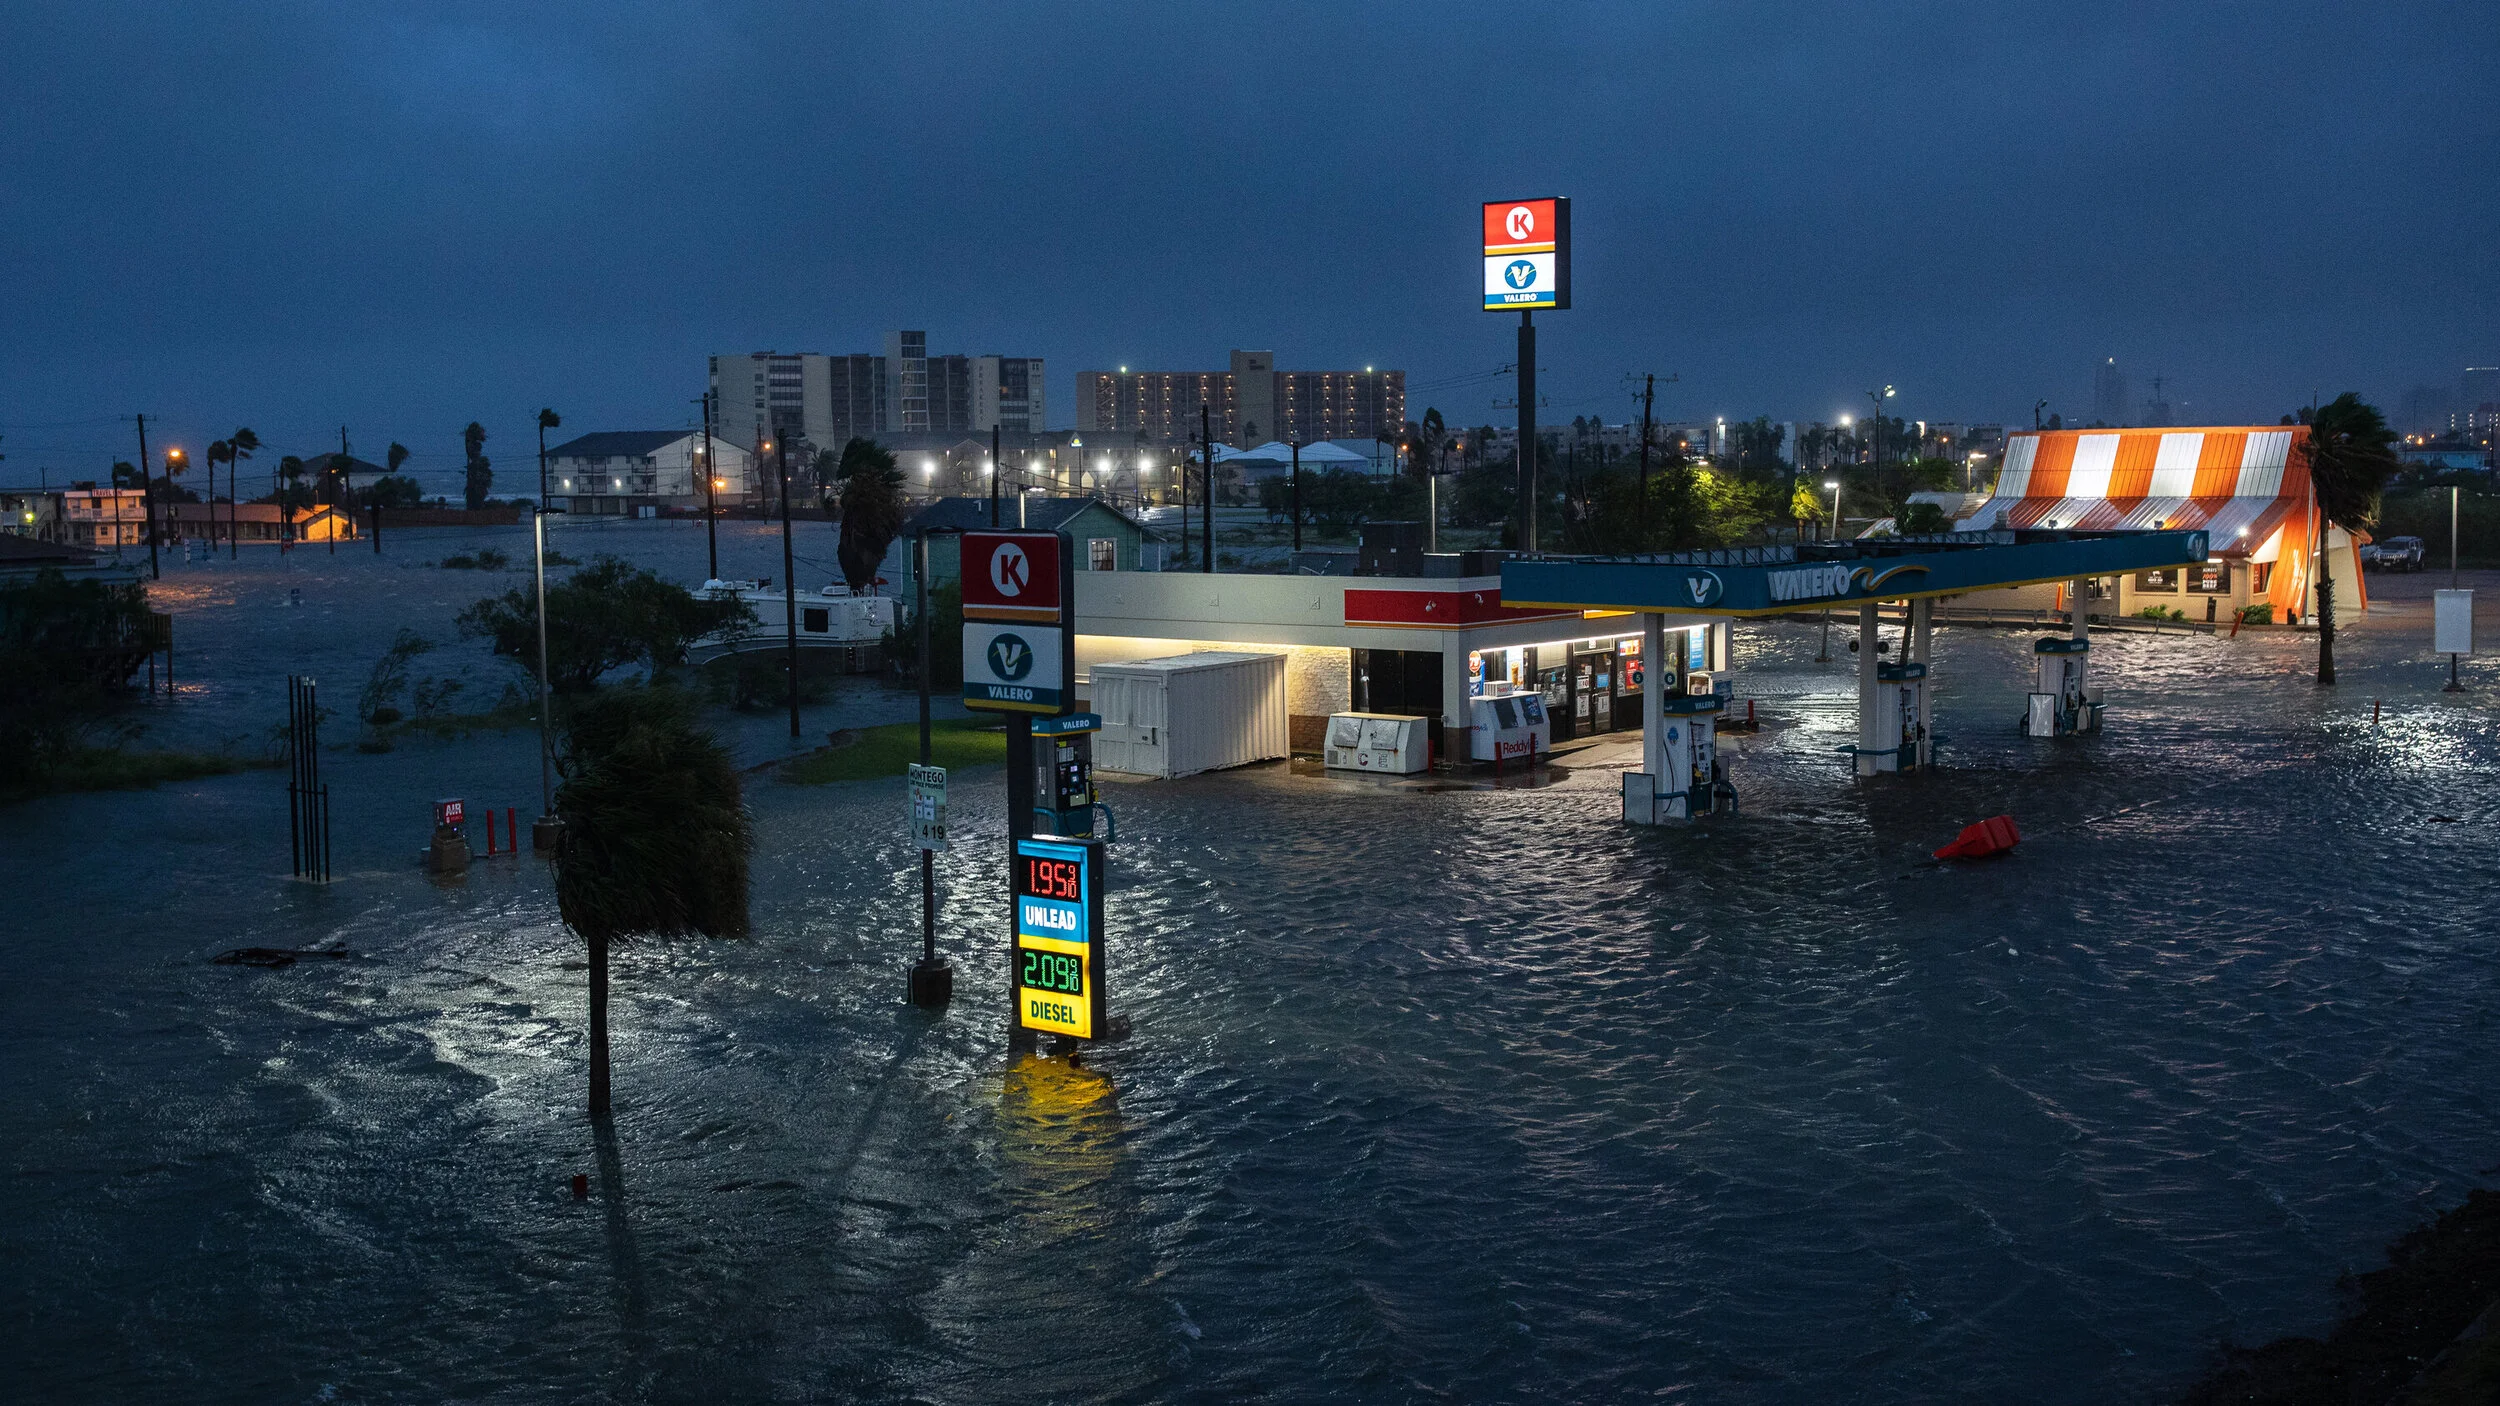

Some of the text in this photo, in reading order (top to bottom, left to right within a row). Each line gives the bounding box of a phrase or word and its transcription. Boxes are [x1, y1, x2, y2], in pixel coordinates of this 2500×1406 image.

[1514, 214, 1531, 237] K
[1504, 293, 1537, 303] VALERO
[1001, 555, 1025, 593] K
[1768, 566, 1850, 601] VALERO
[988, 685, 1033, 701] VALERO
[1694, 701, 1715, 709] VALERO
[1062, 719, 1090, 729] VALERO
[910, 768, 944, 783] MONTEGO
[446, 803, 462, 816] AIR
[1025, 905, 1076, 931] UNLEAD
[1031, 1000, 1076, 1025] DIESEL
